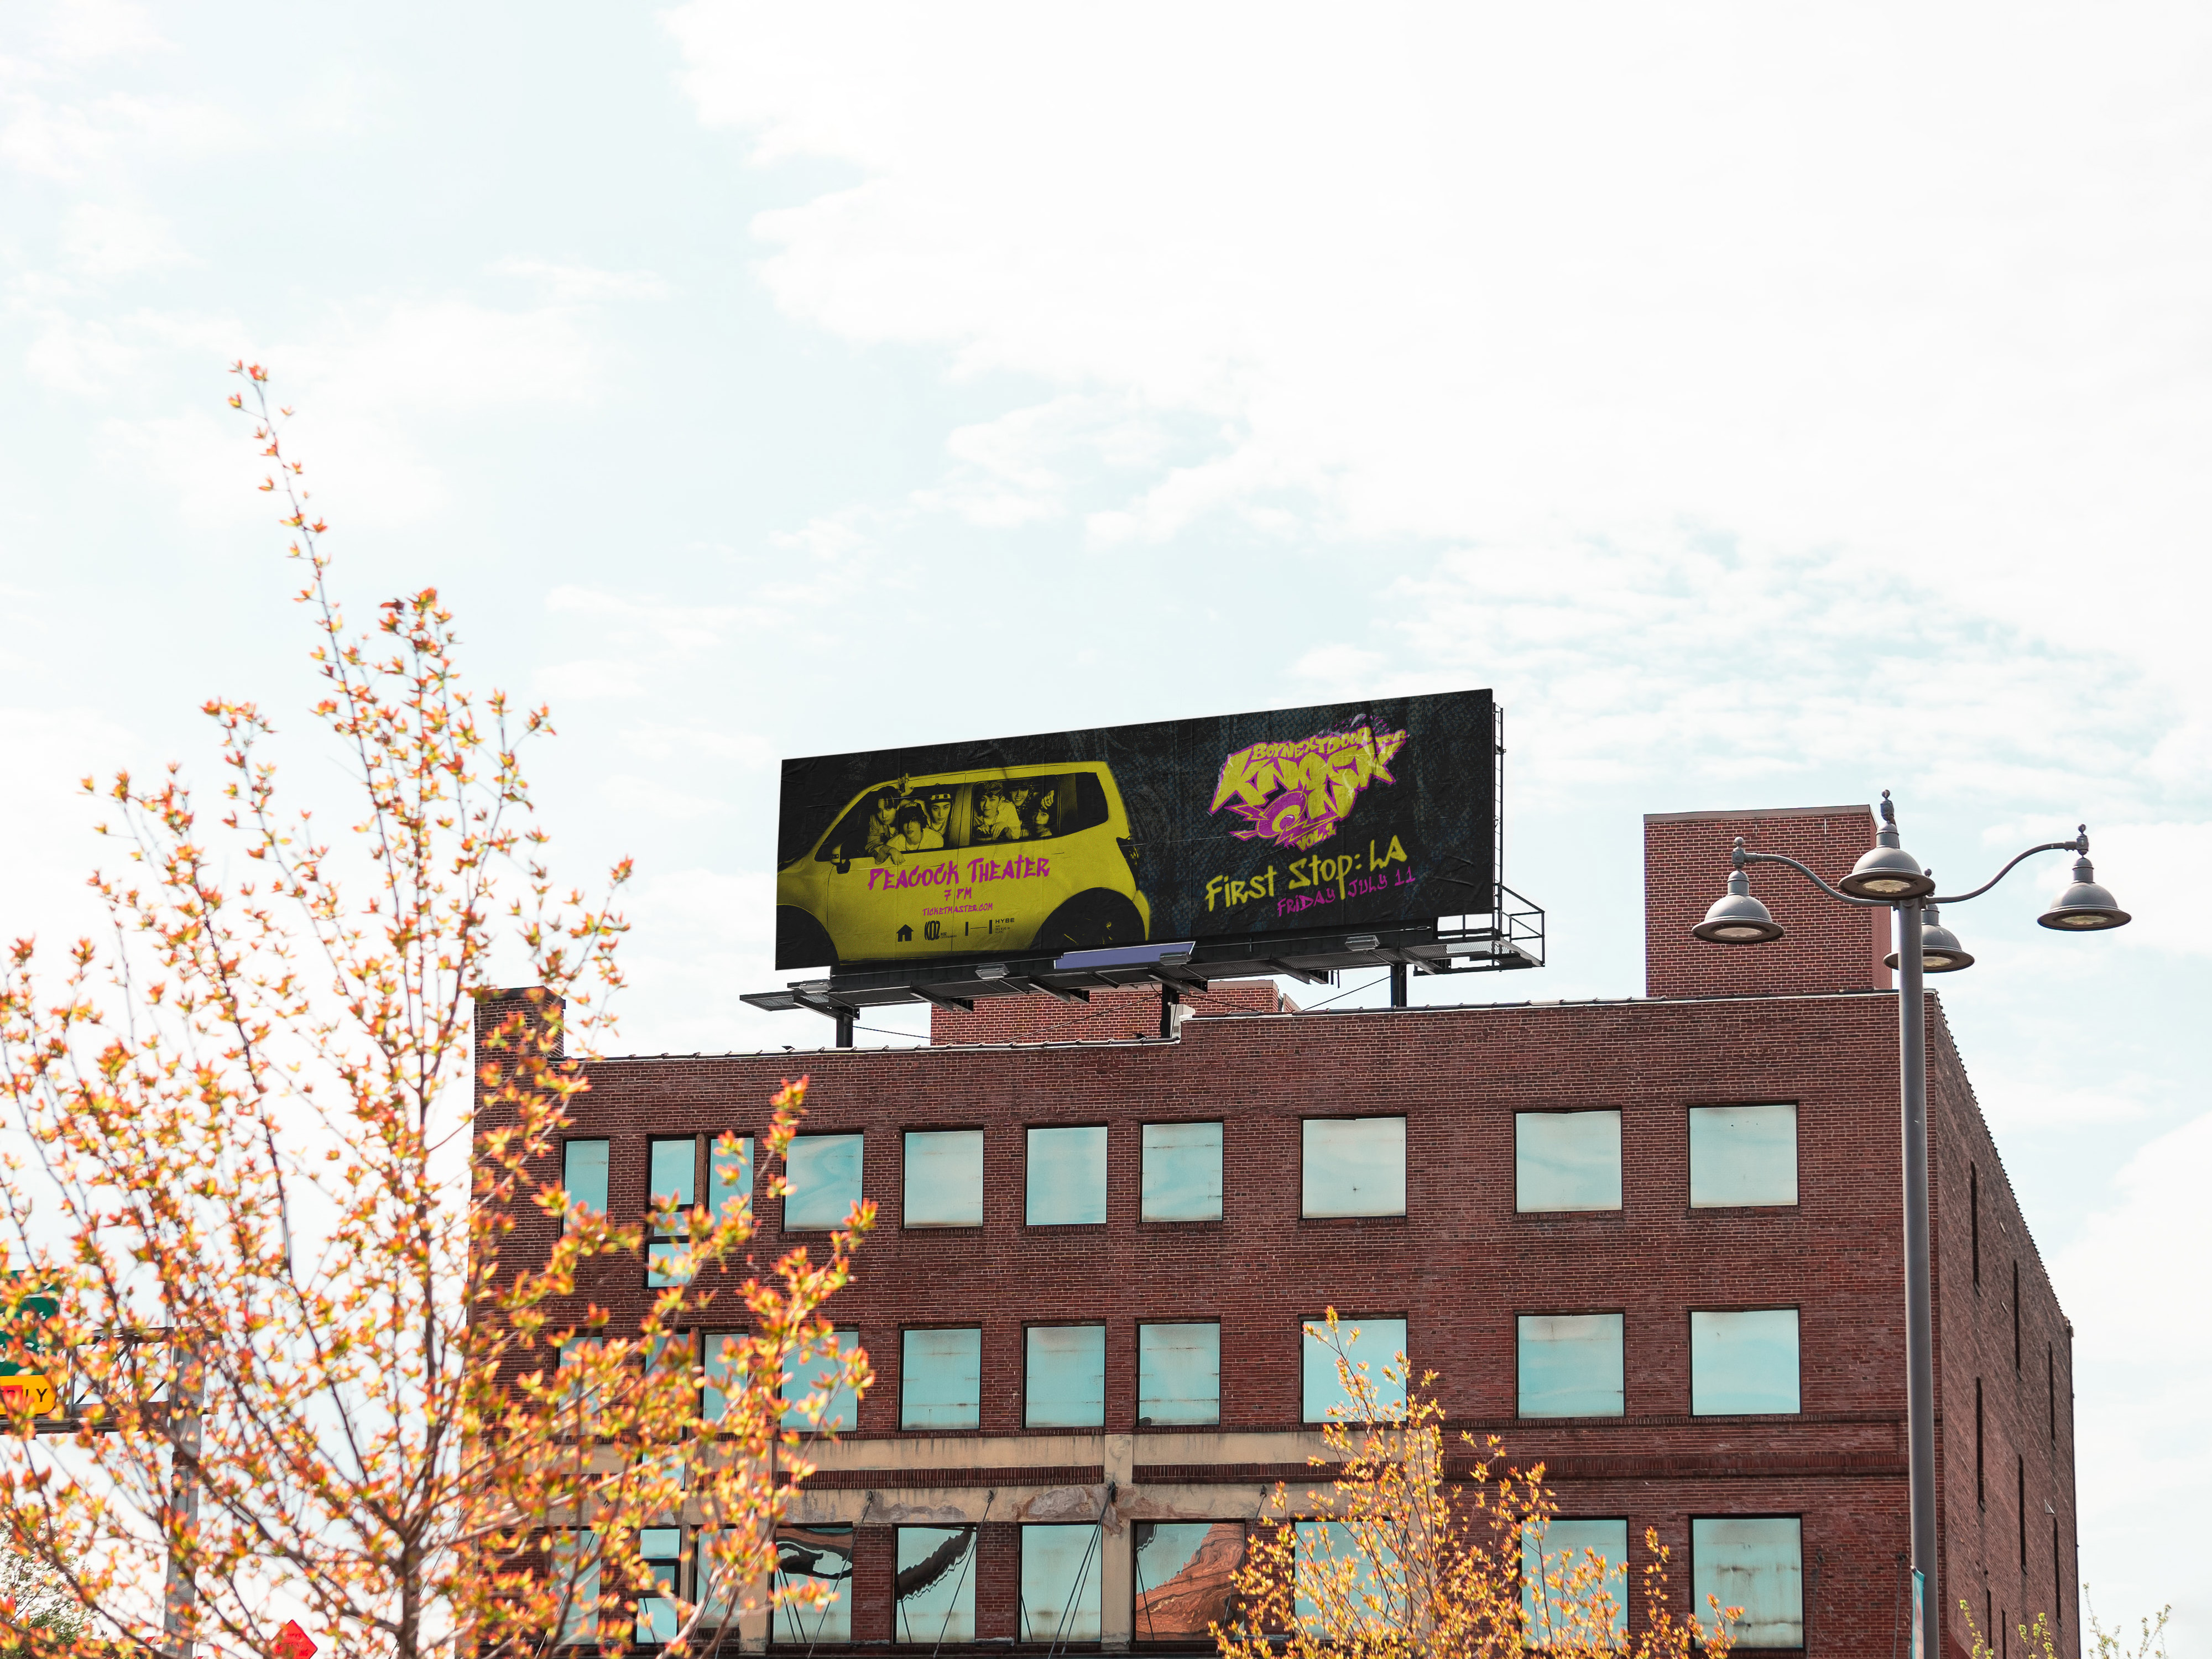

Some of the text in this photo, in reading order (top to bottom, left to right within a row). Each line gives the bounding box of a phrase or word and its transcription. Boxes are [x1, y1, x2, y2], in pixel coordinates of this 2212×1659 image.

[1250, 726, 1406, 760] BOYNEXTDOOR TOUR
[1370, 834, 1407, 872] LA
[868, 860, 959, 890] PEACOCK
[944, 887, 972, 901] 7 PM
[1277, 865, 1416, 917] FRIDAY JULY 11
[922, 902, 993, 916] TICKETMASTER.COM
[925, 920, 940, 941] KOZ
